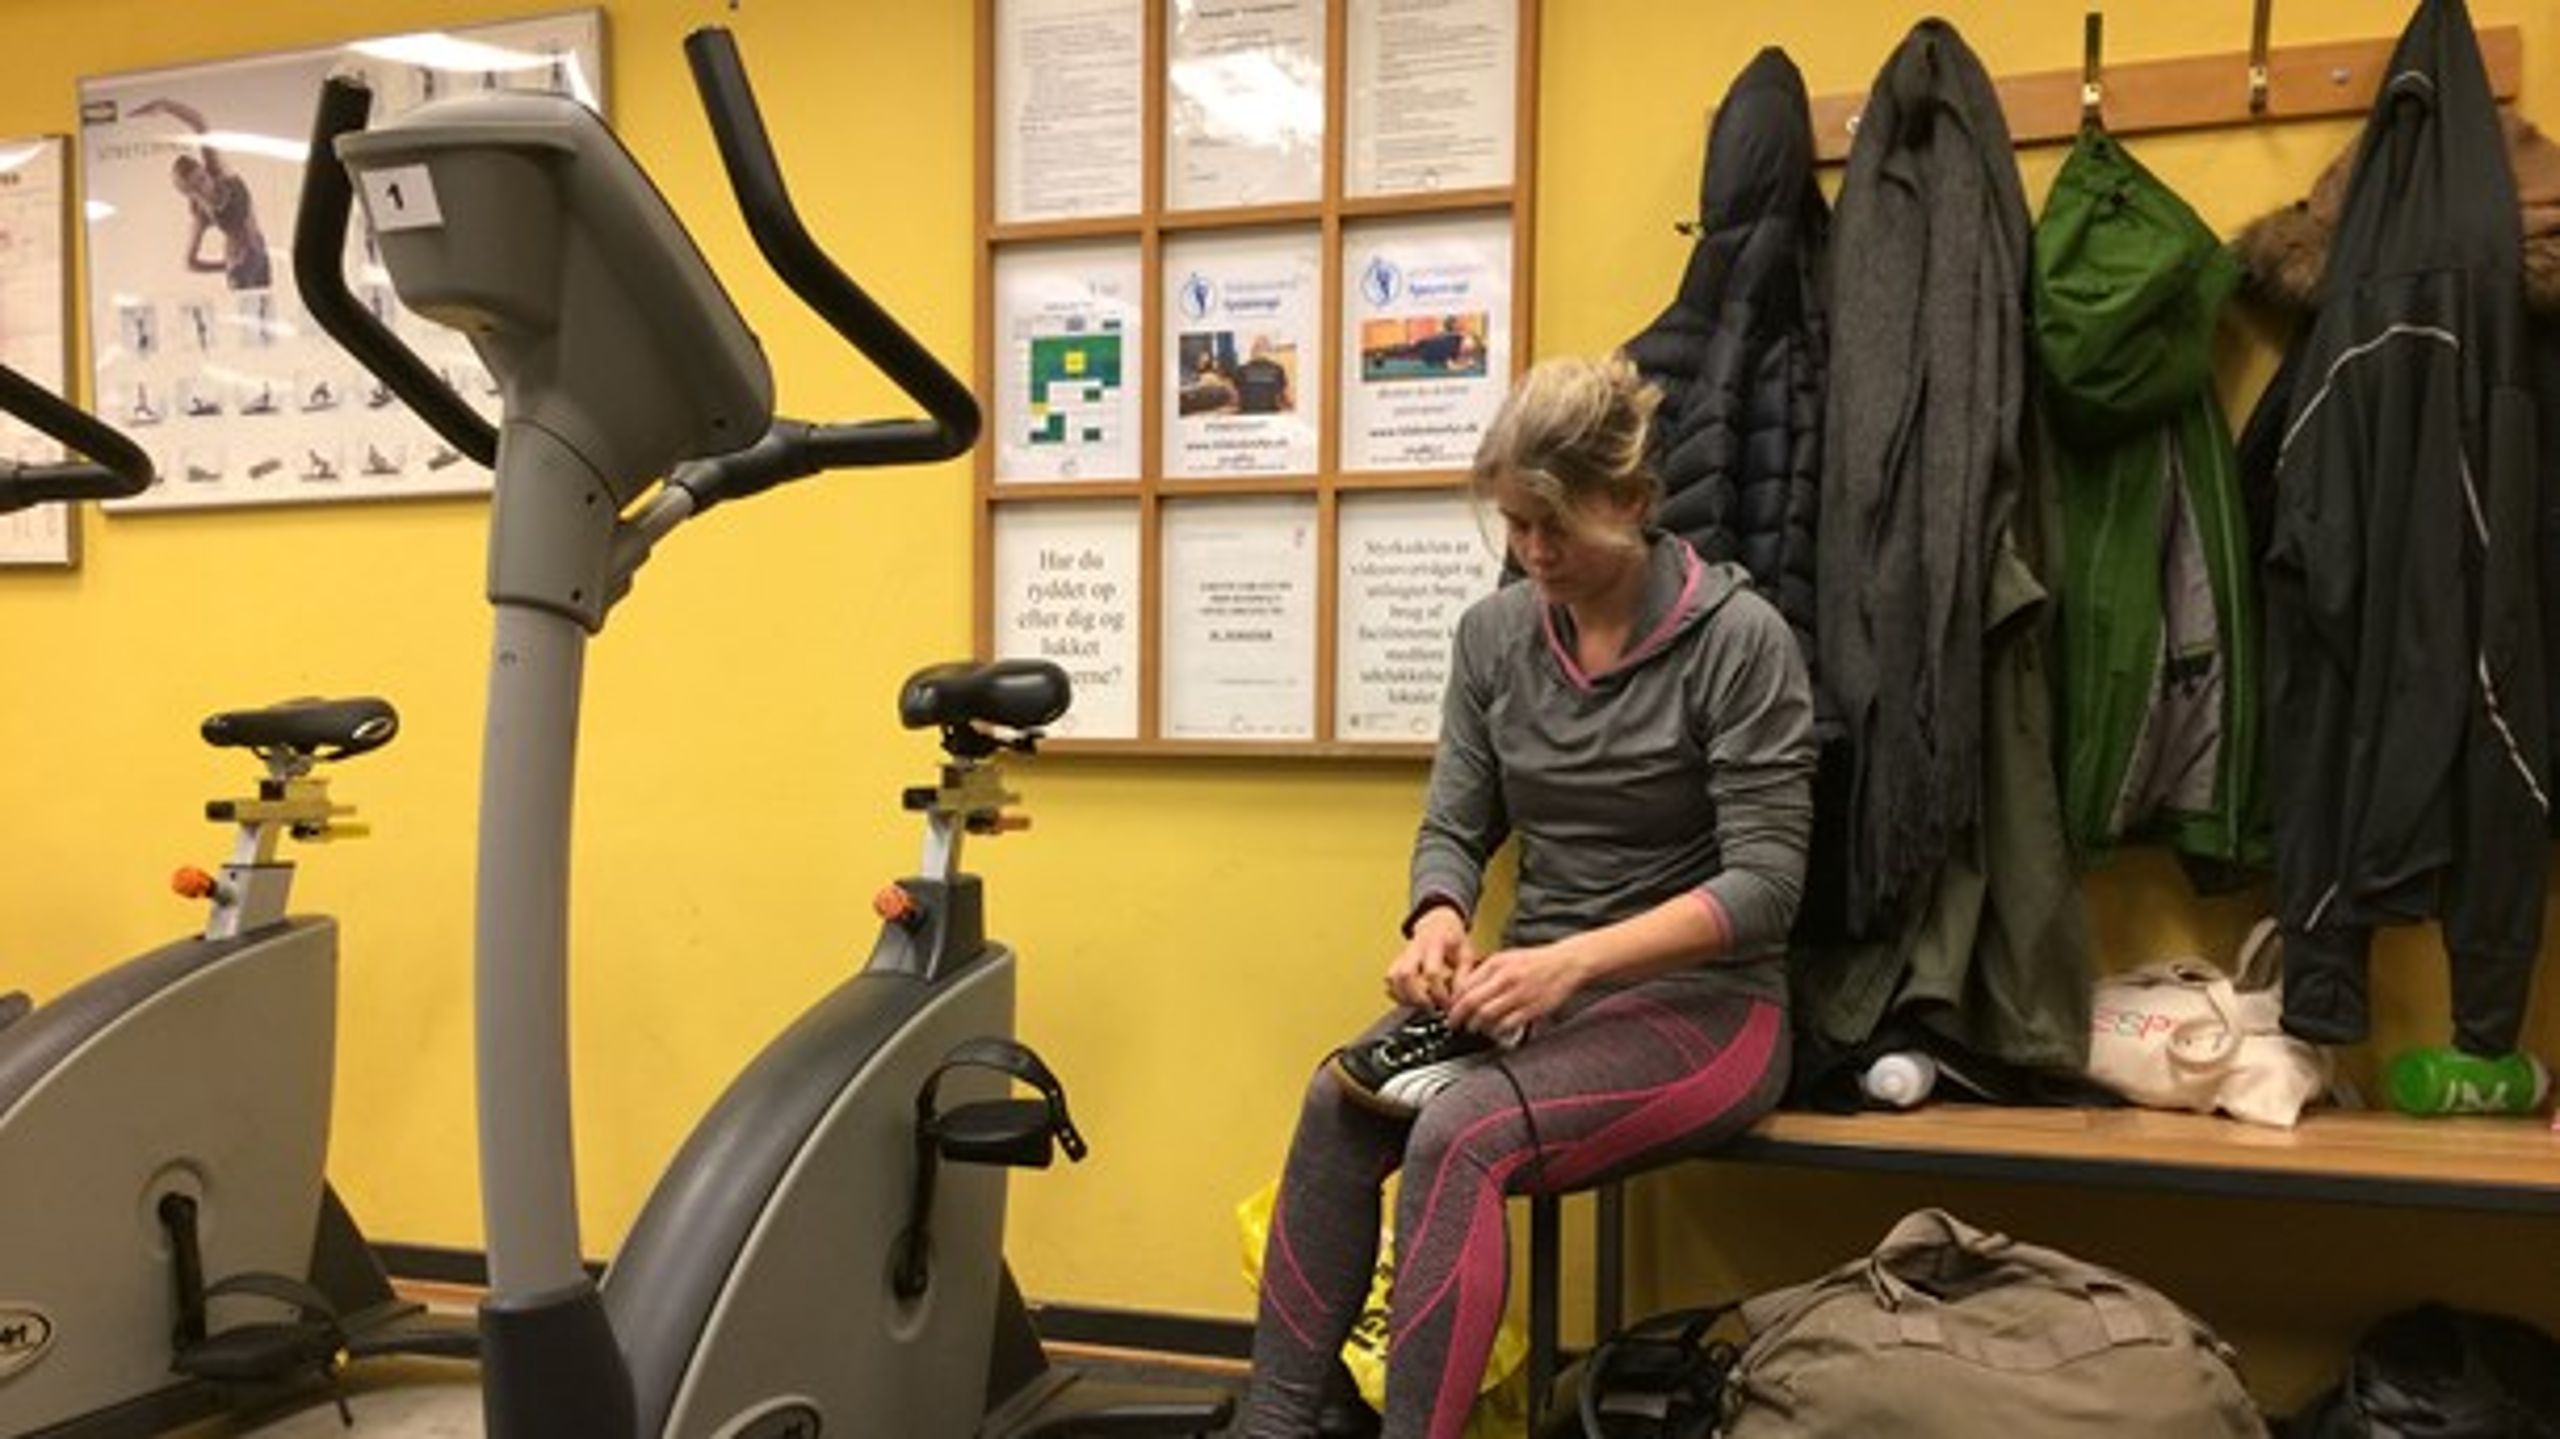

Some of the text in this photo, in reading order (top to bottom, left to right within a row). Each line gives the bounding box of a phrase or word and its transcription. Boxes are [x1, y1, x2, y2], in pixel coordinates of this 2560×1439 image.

[386, 182, 404, 211] 1
[1040, 549, 1104, 570] Har du
[1090, 582, 1117, 603] op
